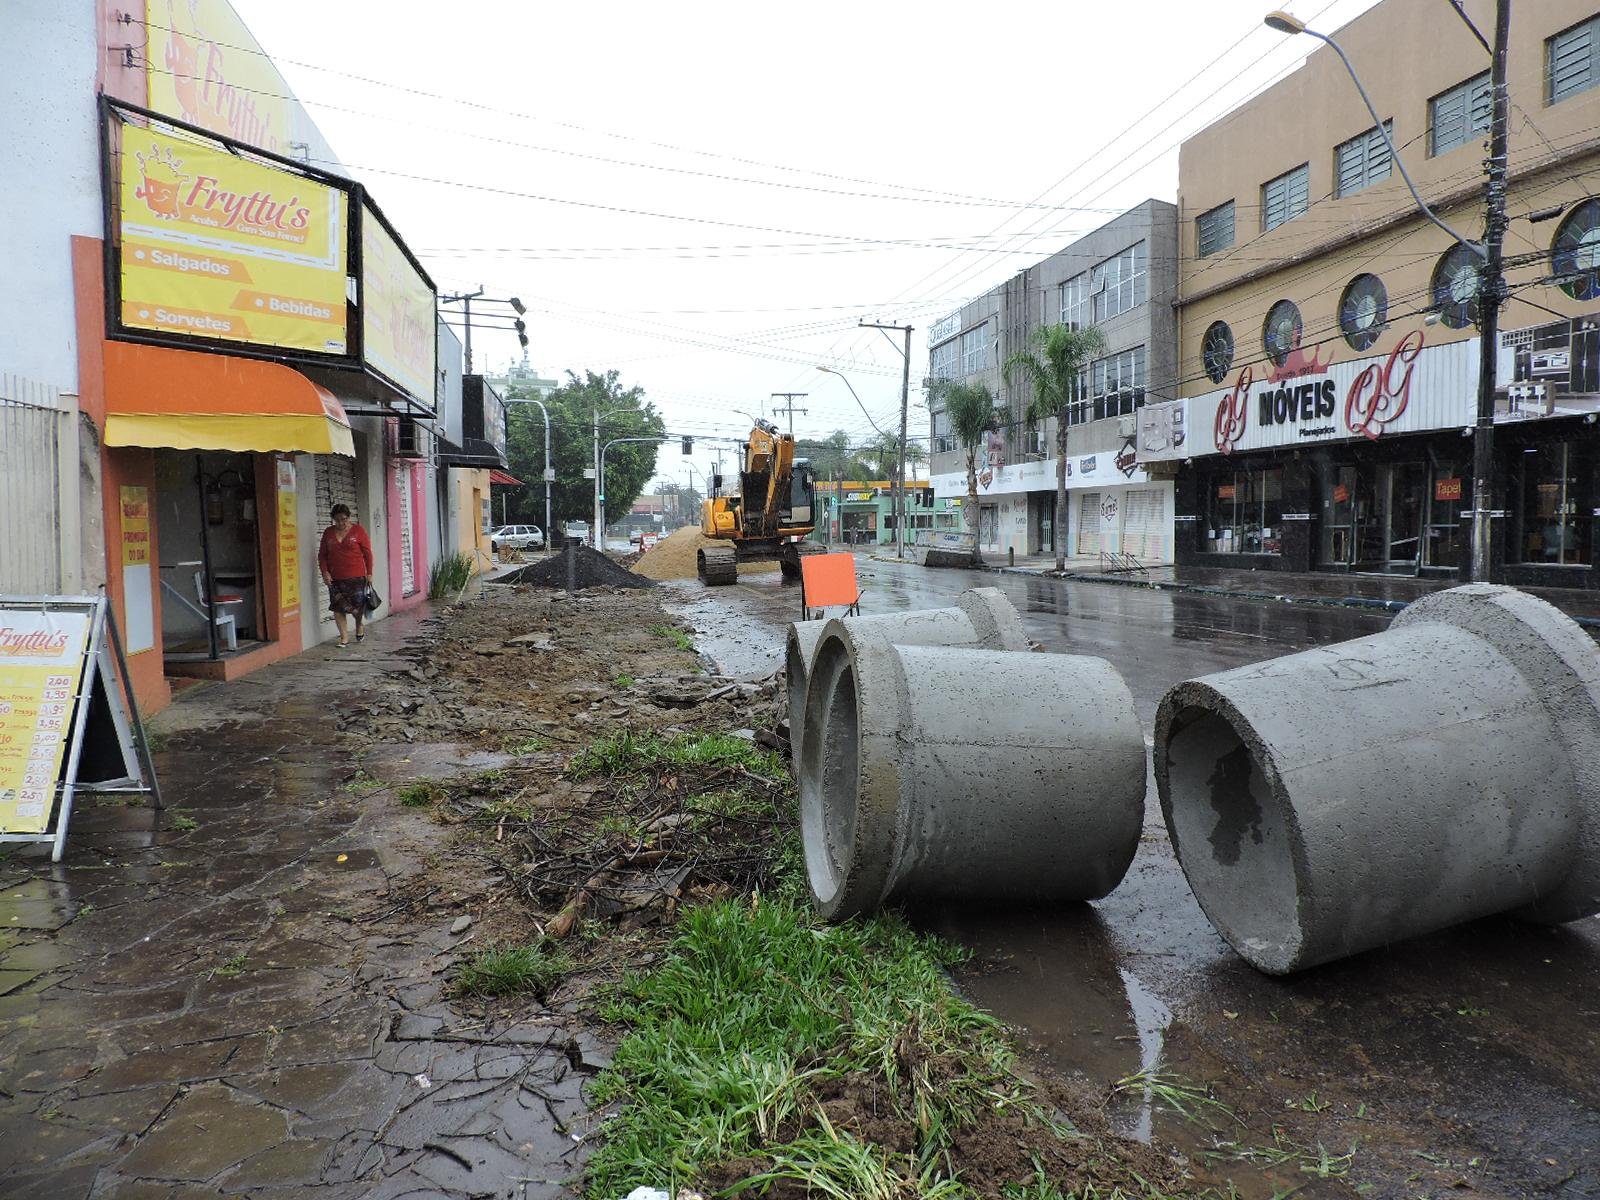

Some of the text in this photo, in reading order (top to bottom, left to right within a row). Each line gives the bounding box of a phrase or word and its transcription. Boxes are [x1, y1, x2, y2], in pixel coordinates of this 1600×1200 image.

[185, 175, 311, 229] Fryttu's
[150, 250, 231, 275] Salgados
[268, 297, 331, 319] Bebidas
[155, 309, 232, 332] Sorvetes
[1259, 380, 1336, 426] MÓVEIS
[1299, 425, 1336, 438] Planejados
